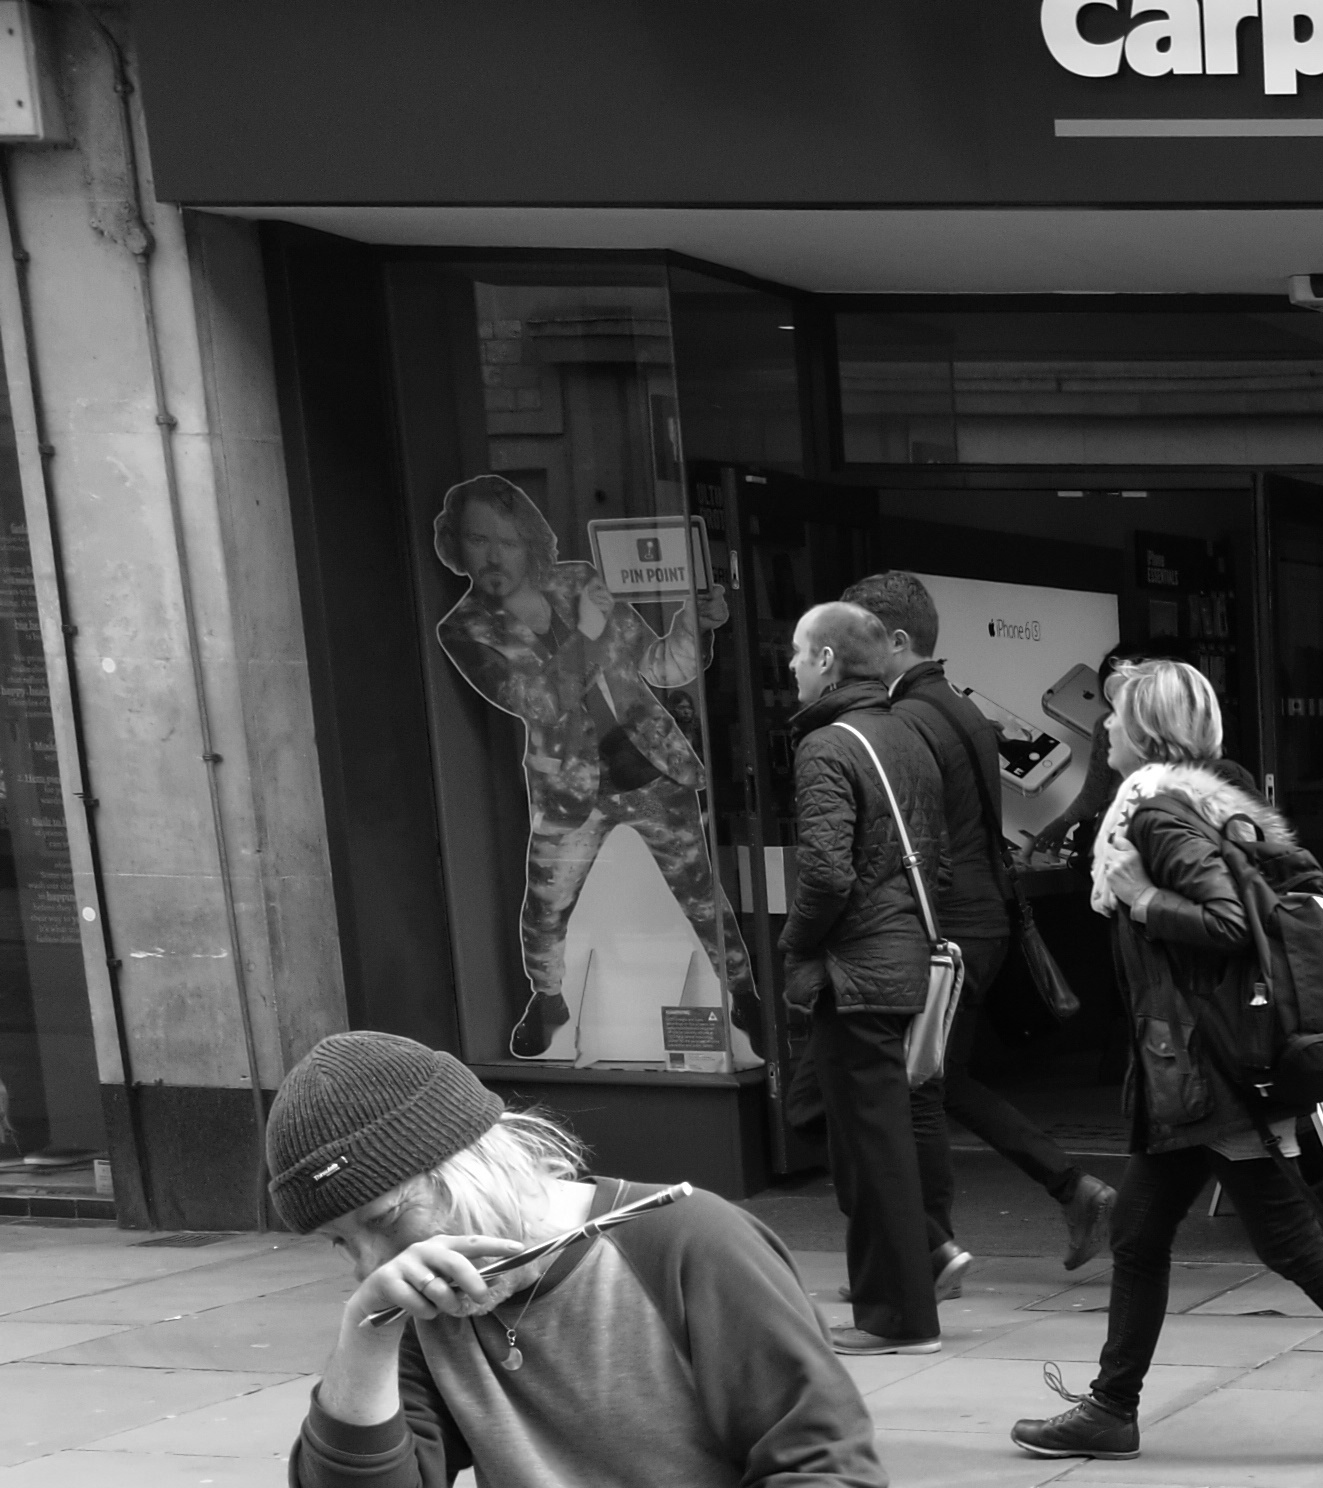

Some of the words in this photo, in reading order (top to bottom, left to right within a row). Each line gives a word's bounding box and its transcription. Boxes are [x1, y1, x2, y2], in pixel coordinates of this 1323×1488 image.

[620, 569, 645, 584] PIN
[646, 567, 686, 583] POINT
[996, 619, 1024, 640] iPhone
